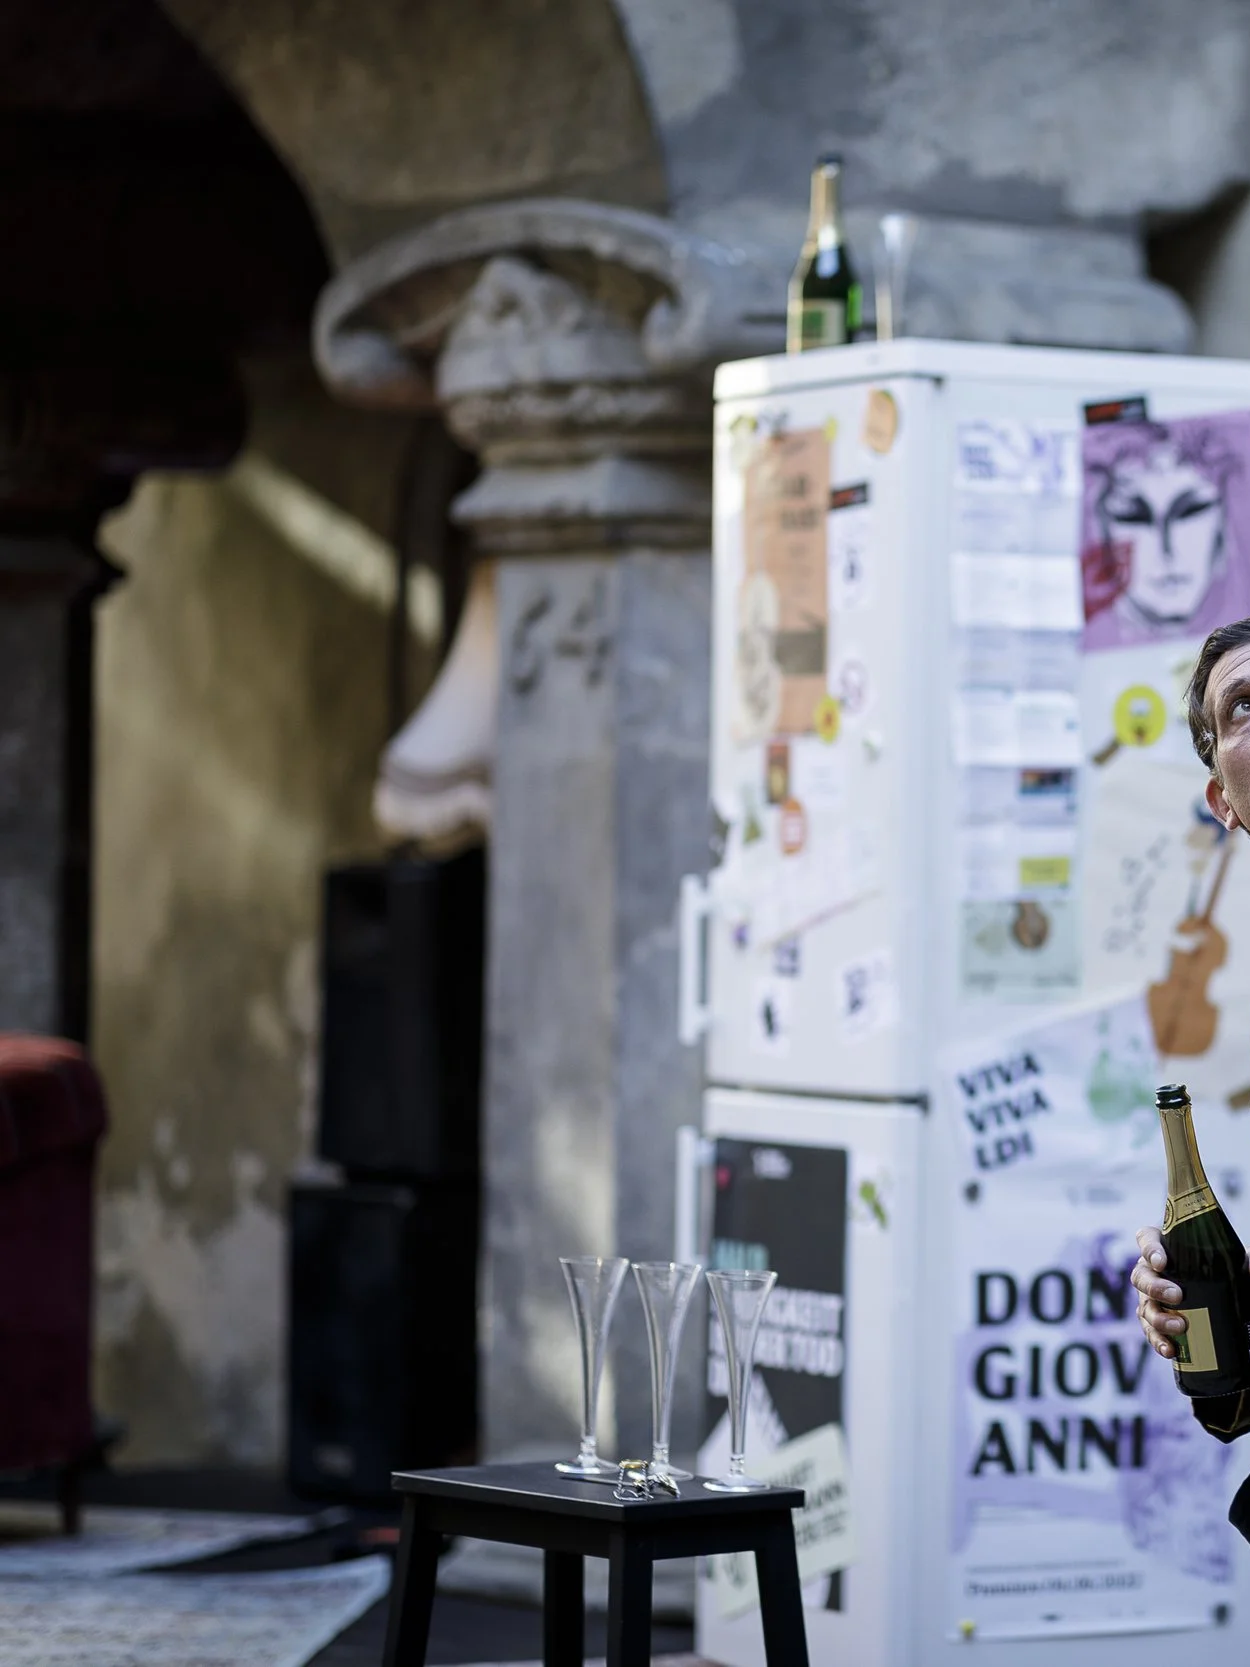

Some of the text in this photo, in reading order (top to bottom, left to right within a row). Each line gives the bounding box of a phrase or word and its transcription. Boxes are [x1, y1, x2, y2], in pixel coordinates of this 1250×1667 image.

[958, 1050, 1043, 1098] VIVA
[967, 1088, 1051, 1133] VIVA
[976, 1130, 1034, 1171] LDI
[975, 1267, 1128, 1326] DON
[974, 1342, 1149, 1401] GIOV
[969, 1414, 1146, 1478] ANNI
